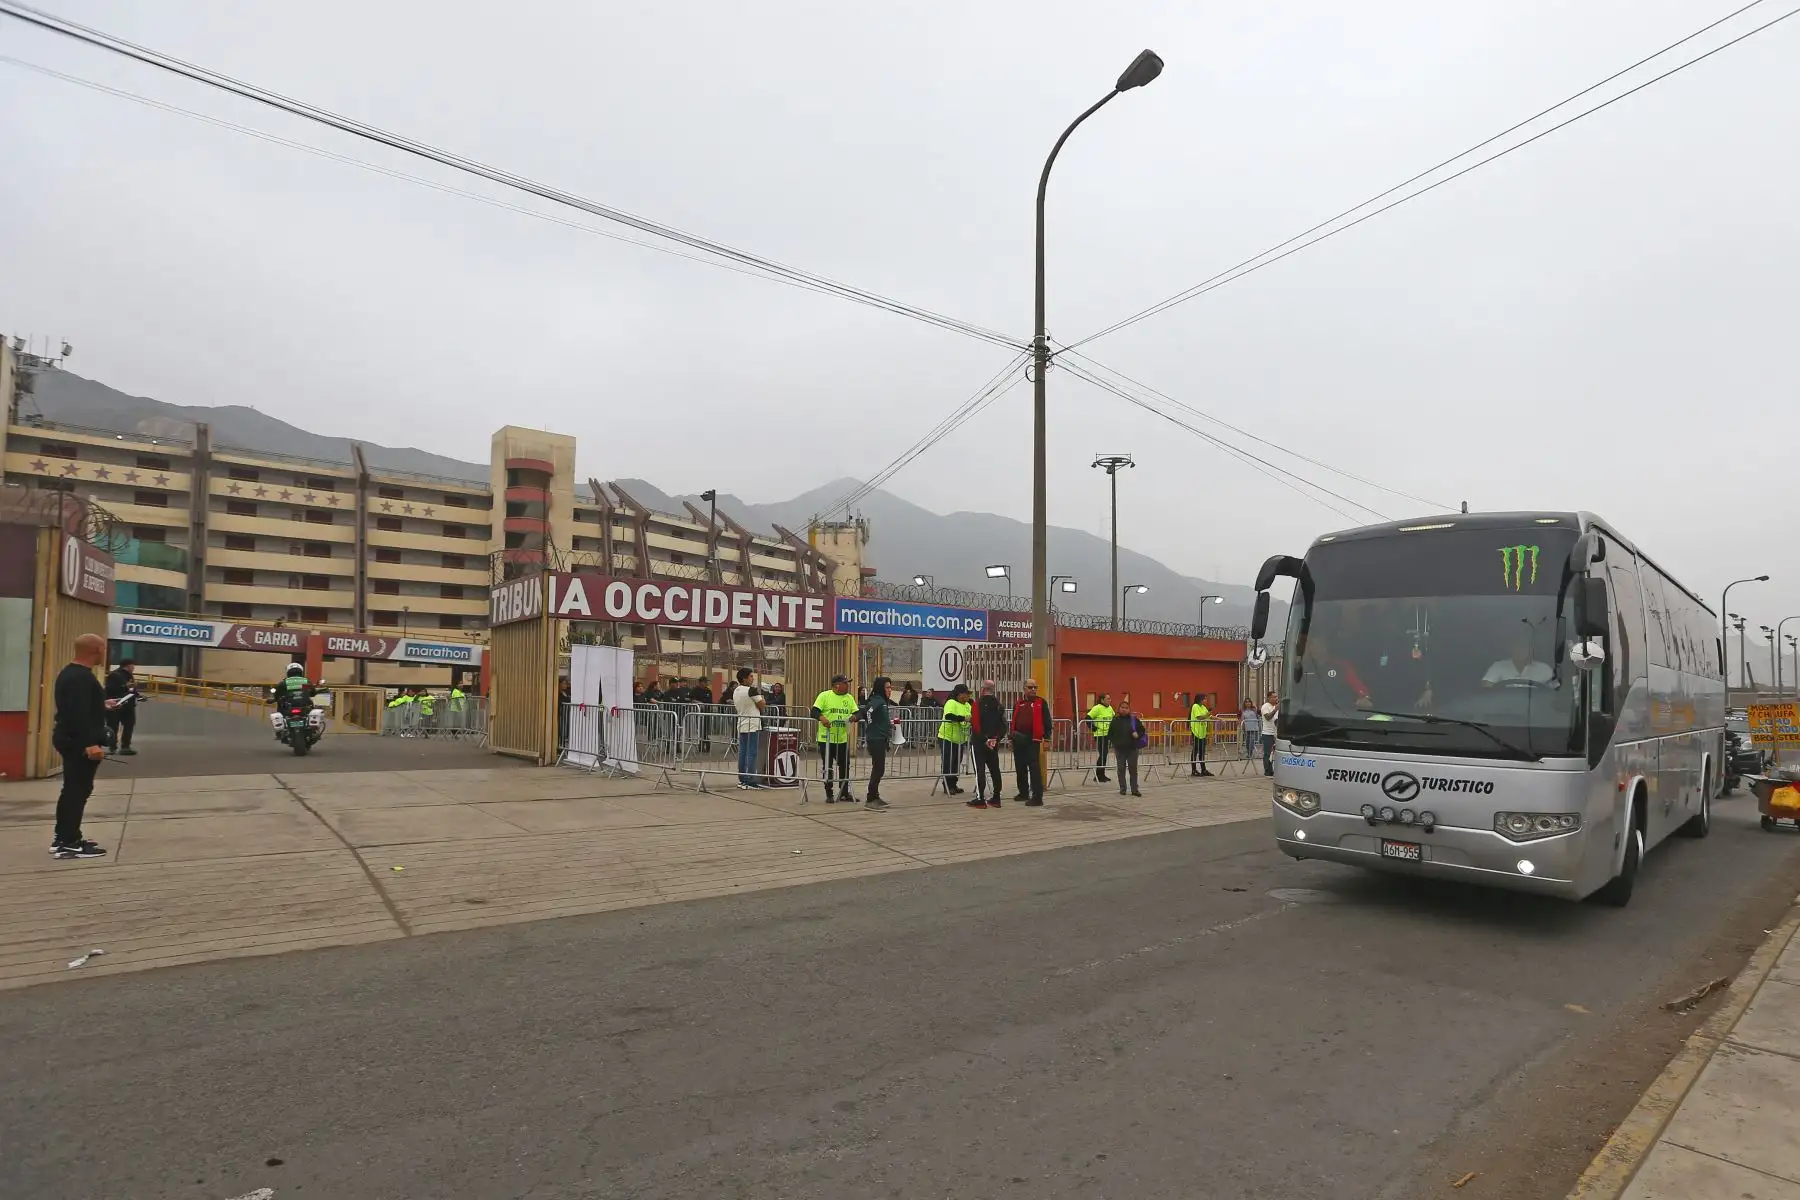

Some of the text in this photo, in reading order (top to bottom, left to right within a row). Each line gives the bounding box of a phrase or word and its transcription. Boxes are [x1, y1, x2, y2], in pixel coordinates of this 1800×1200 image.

[604, 581, 824, 630] OCCIDENTE
[841, 607, 983, 634] marathon.com.pe
[998, 620, 1021, 629] ACCESO
[125, 623, 210, 639] marathon
[1002, 630, 1032, 639] PREFEREN
[254, 631, 370, 653] GARRA CREMA
[407, 645, 469, 659] marathon
[1326, 768, 1495, 795] SERVICIO TURISTICO
